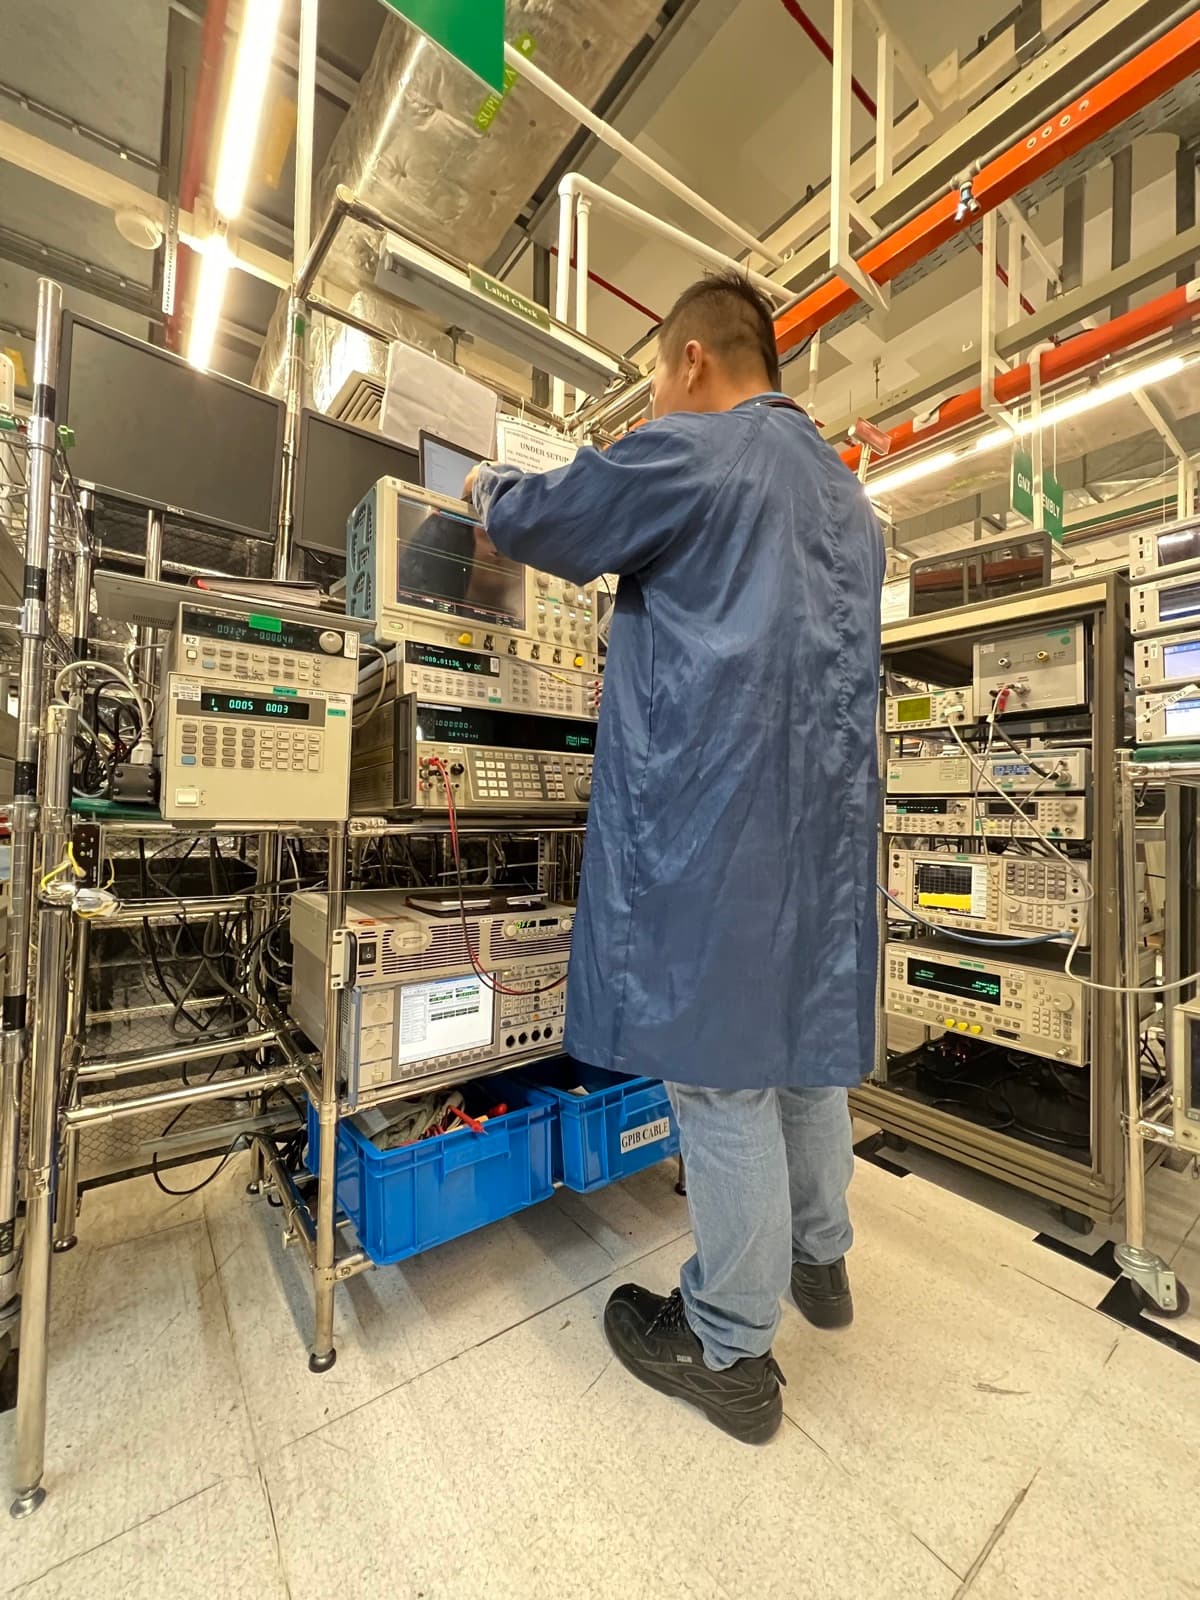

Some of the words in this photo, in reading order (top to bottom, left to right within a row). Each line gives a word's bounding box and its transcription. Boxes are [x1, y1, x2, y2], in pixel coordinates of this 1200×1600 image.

[484, 281, 510, 302] Label
[511, 298, 538, 319] Check
[520, 442, 545, 457] UNDER
[546, 451, 569, 463] SETUP
[1017, 472, 1031, 495] GNX
[185, 636, 198, 645] K2
[621, 1131, 641, 1148] GPIB
[642, 1120, 668, 1140] CABLE
